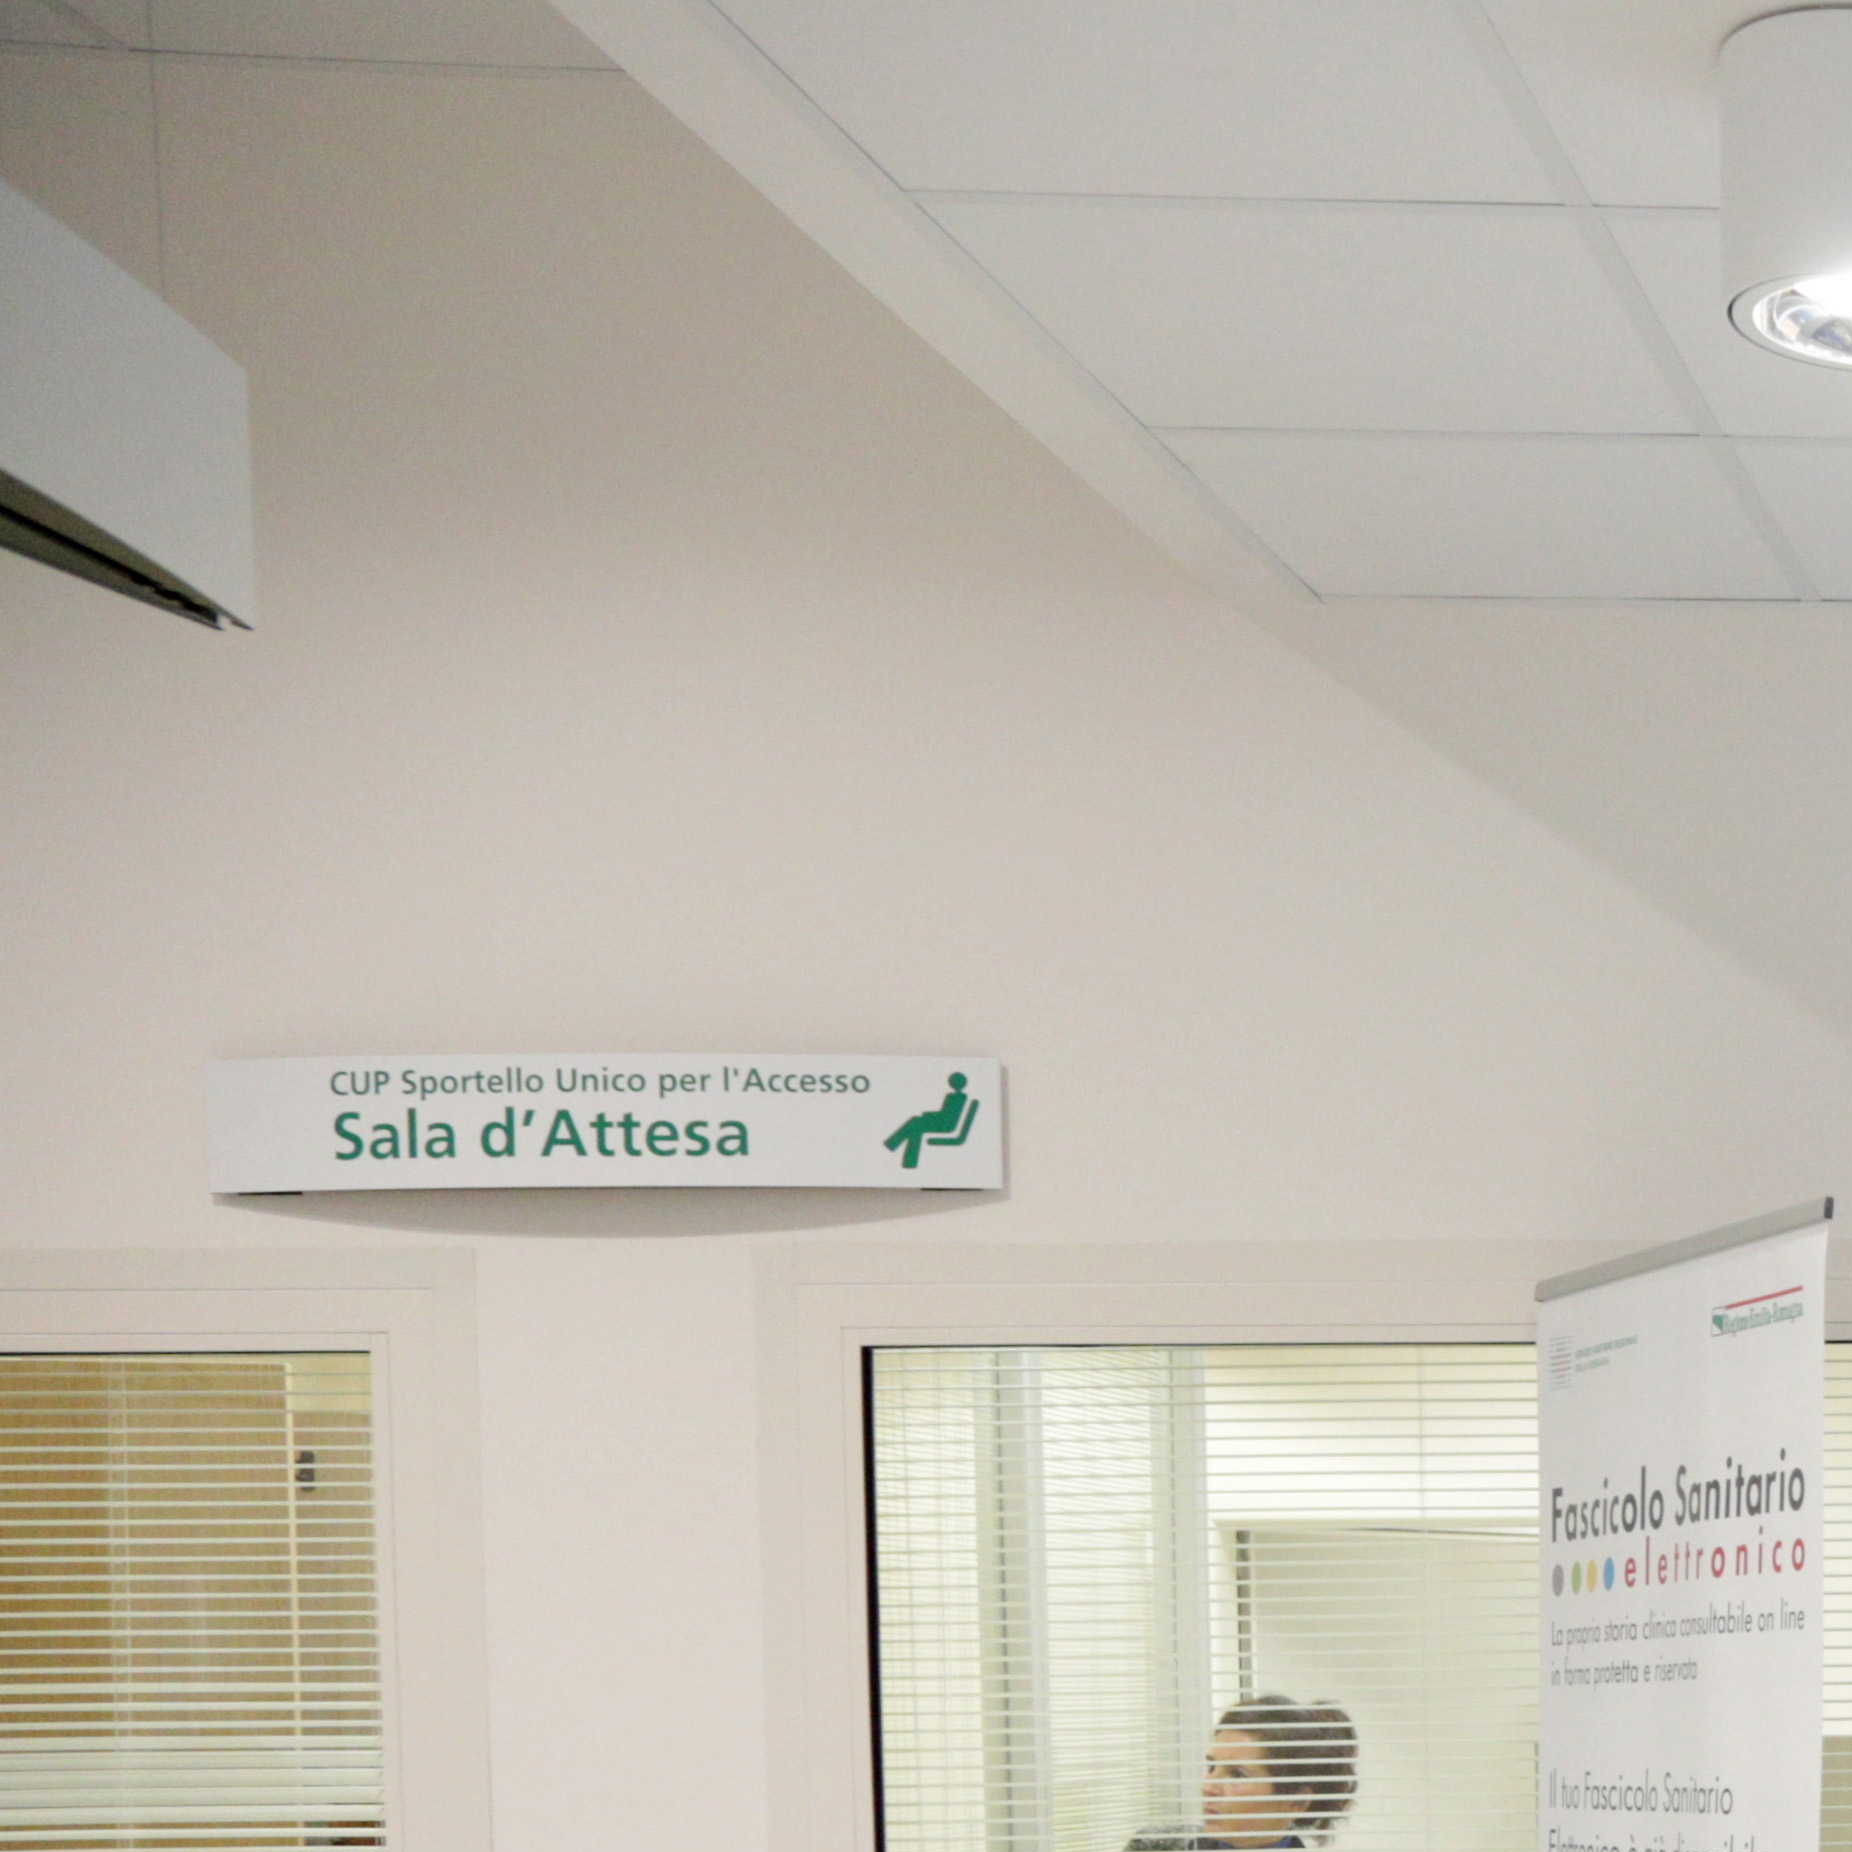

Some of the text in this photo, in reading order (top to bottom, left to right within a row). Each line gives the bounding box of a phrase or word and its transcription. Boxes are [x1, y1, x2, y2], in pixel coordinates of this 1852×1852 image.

[330, 1067, 871, 1100] CUP Sportello Unico per l'Accesso
[333, 1107, 749, 1160] Sala d'Attesa
[1552, 1447, 1805, 1543] Fascicolo Sanitario
[1625, 1526, 1806, 1587] elettronico
[1552, 1598, 1805, 1652] La propria storia clinica consultabile on line
[1551, 1656, 1698, 1691] in forma protetta e riservata
[1549, 1768, 1733, 1815] Il tuo Fascicolo Sanitario
